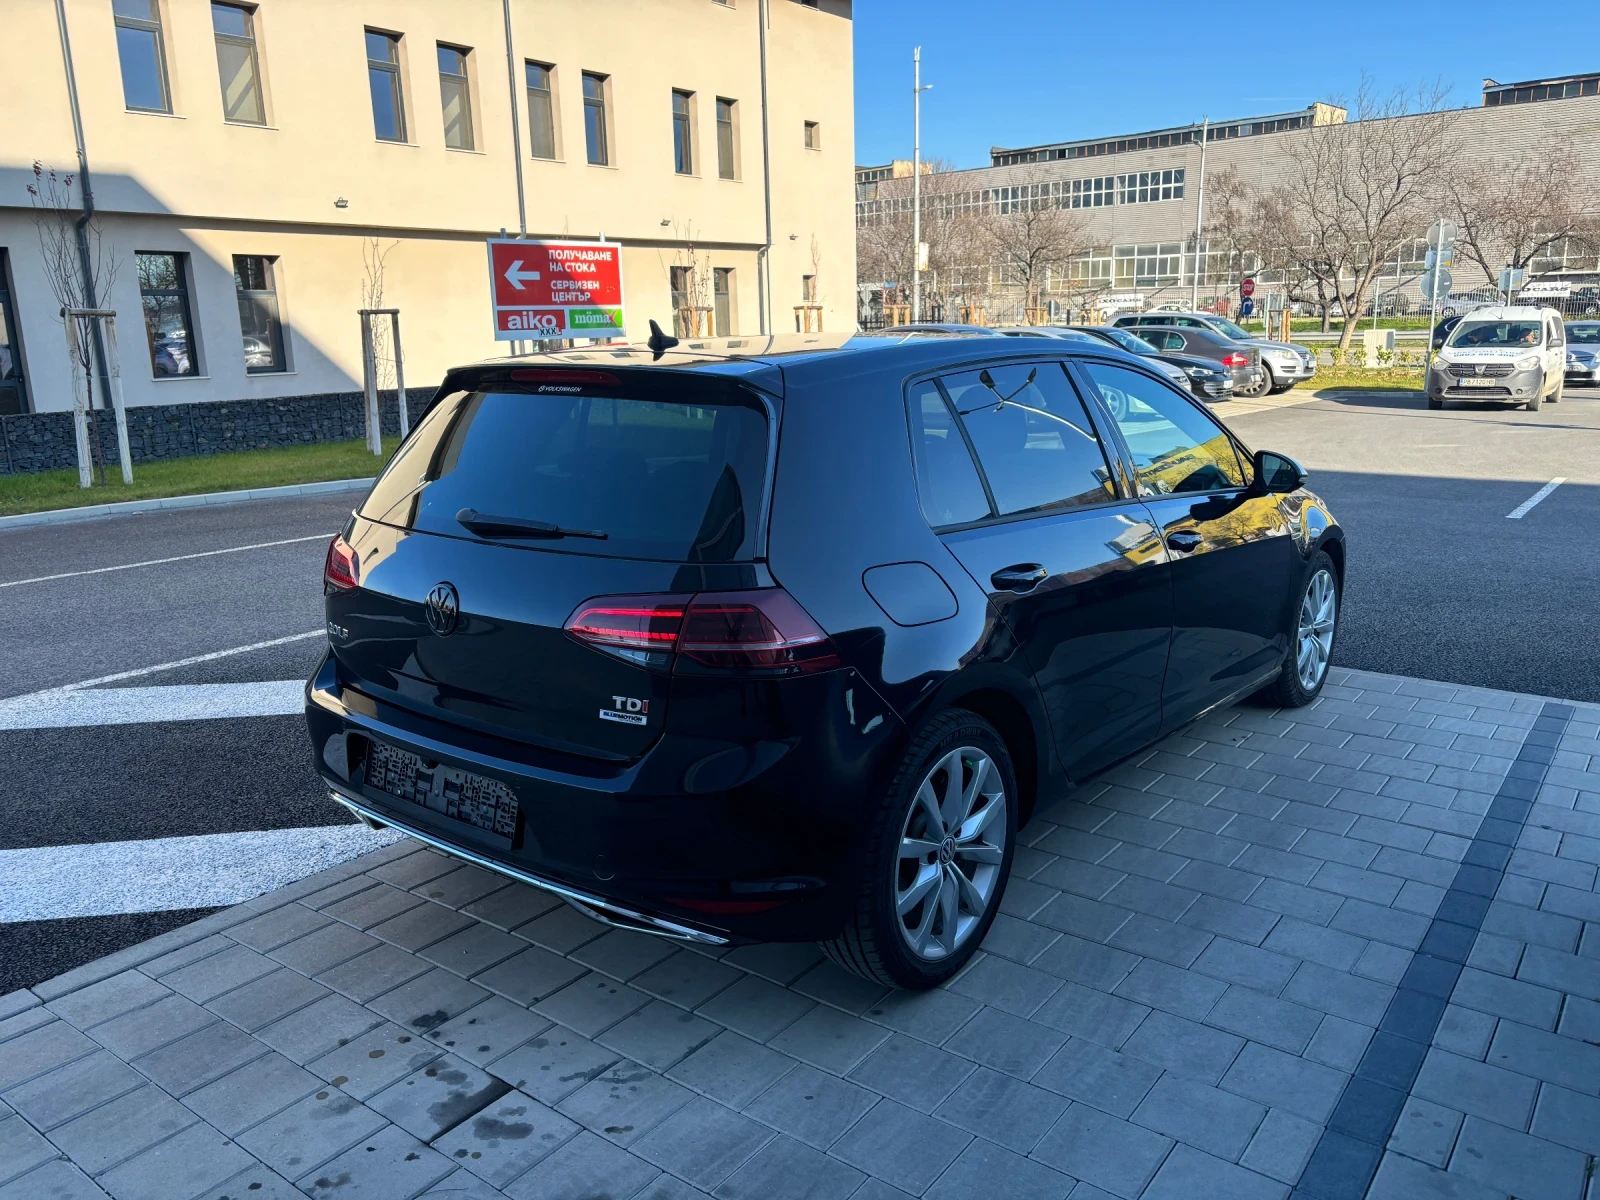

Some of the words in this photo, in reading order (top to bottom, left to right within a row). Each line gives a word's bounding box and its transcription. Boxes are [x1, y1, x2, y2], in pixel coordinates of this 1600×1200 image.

[548, 249, 612, 261] ПОЛУЧАВАНЕ
[549, 262, 563, 272] НА
[565, 262, 596, 273] СТОКА
[550, 280, 599, 290] СЕРВИЗЕН
[551, 291, 591, 303] ЦЕНТЪР
[507, 311, 557, 329] aiko
[540, 327, 562, 336] XXXL
[544, 385, 582, 393] VOLKSWAGEN
[612, 695, 649, 713] TDI
[603, 711, 643, 722] BLUEMOTION
[940, 727, 982, 750] HEADWAY
